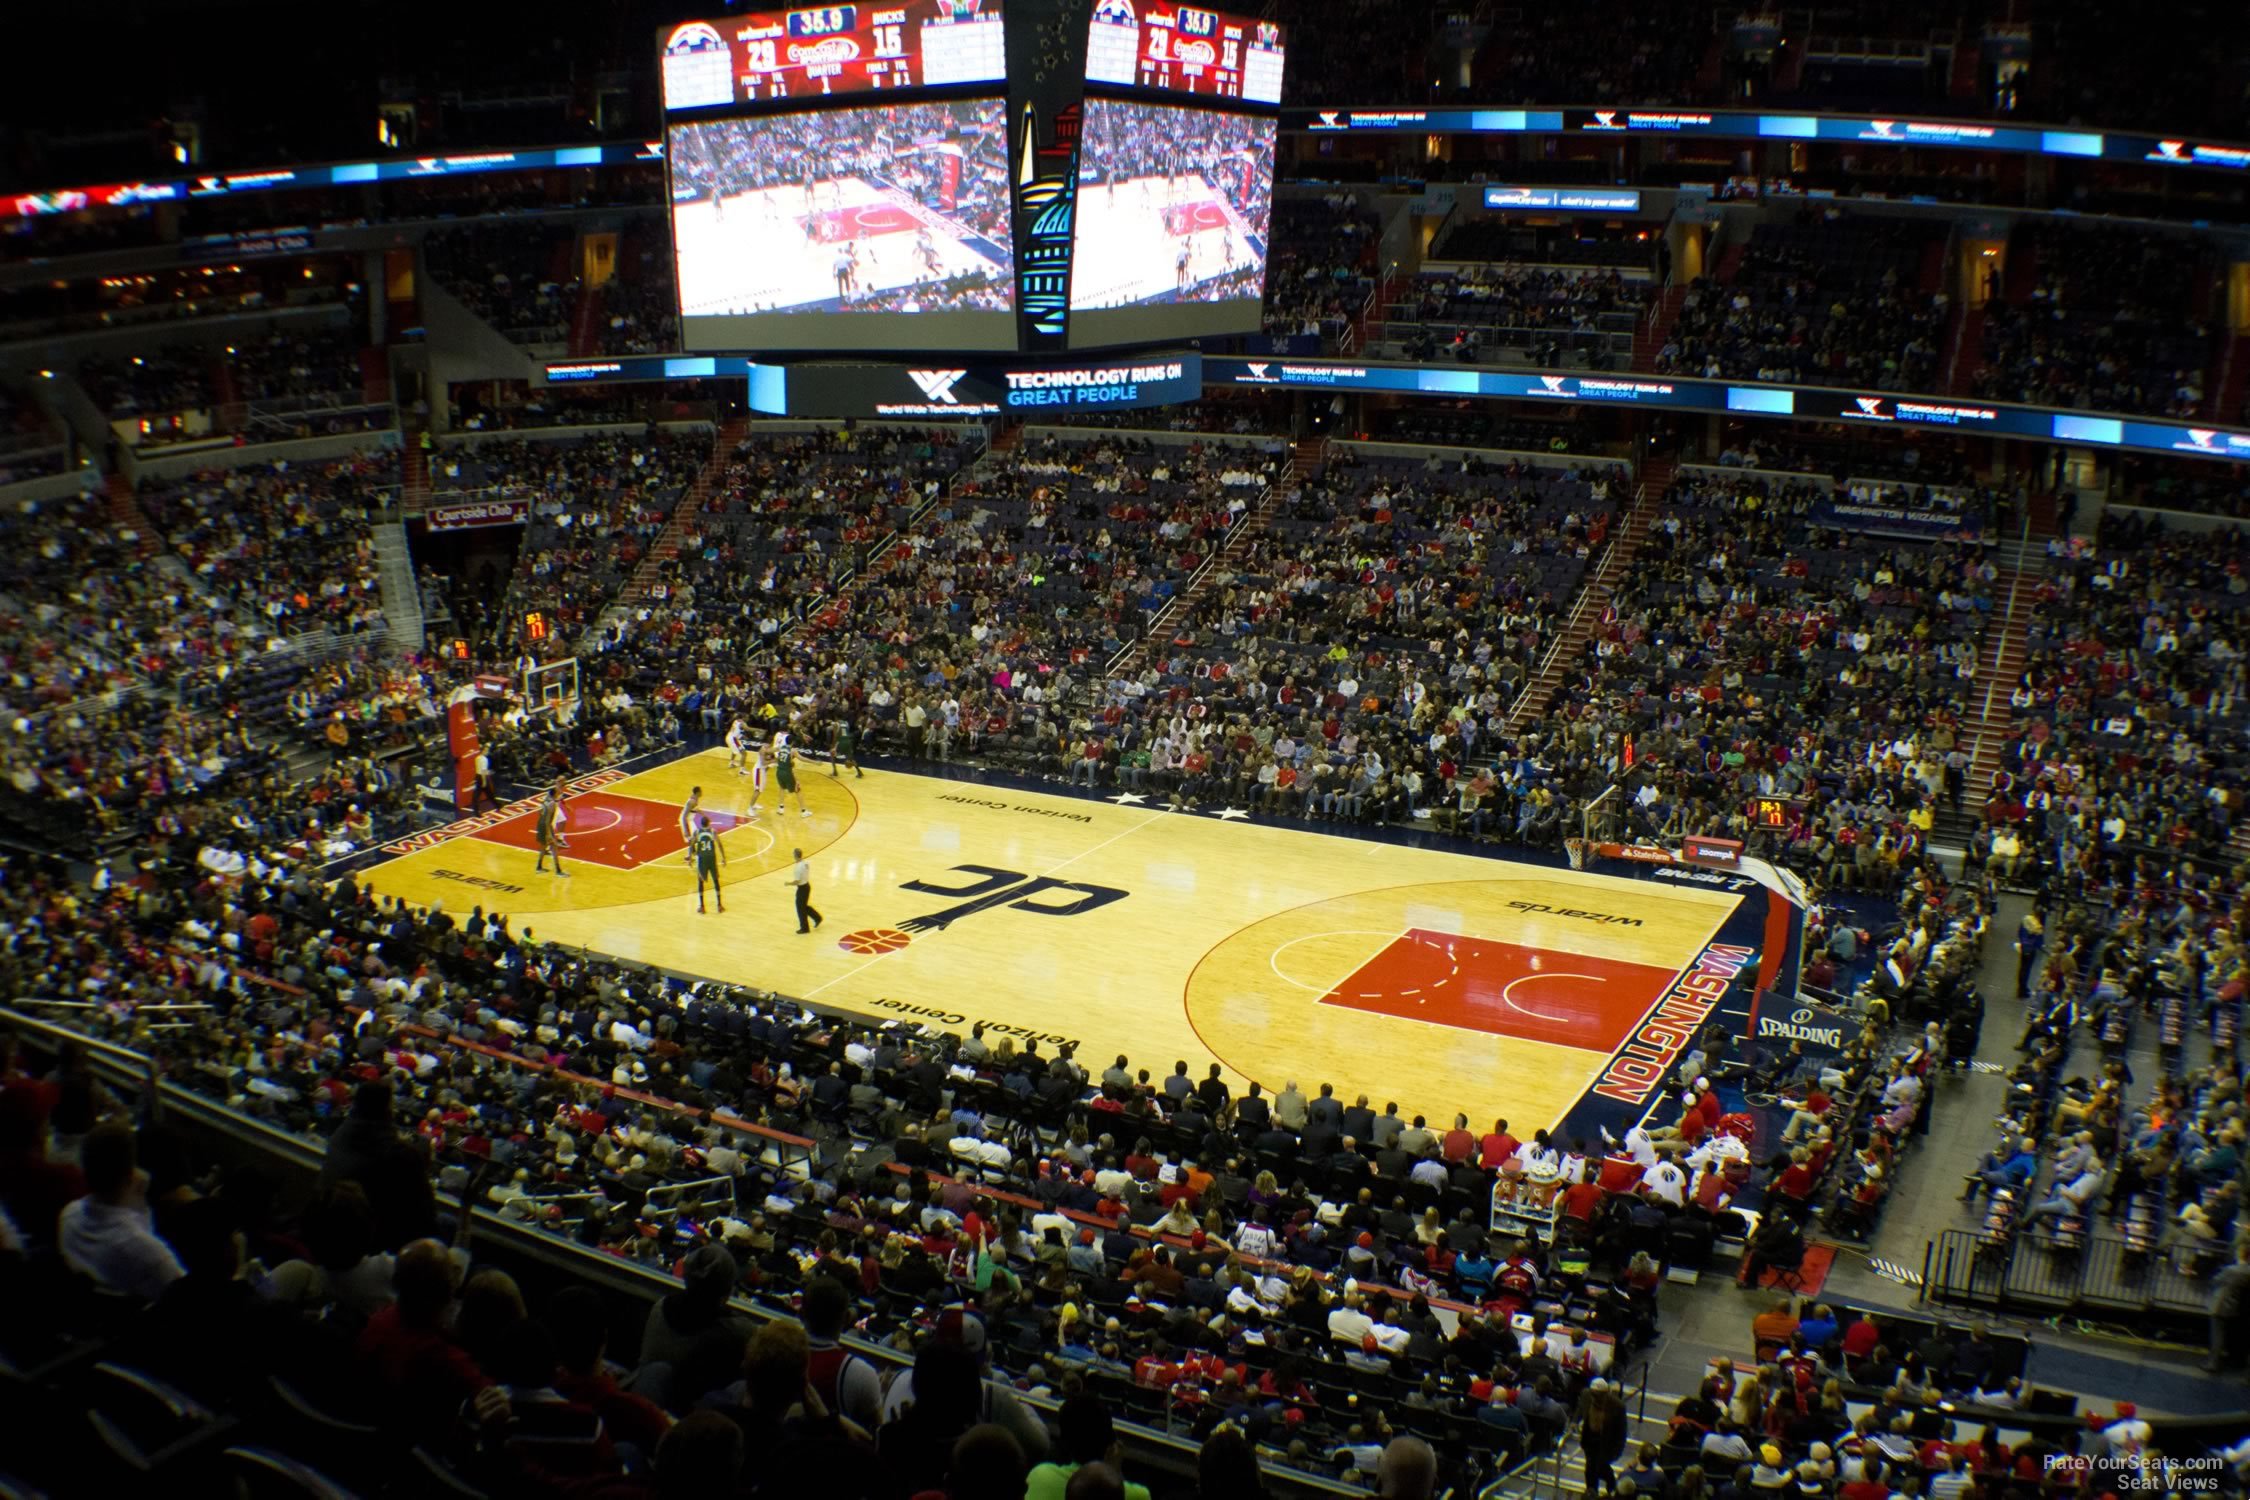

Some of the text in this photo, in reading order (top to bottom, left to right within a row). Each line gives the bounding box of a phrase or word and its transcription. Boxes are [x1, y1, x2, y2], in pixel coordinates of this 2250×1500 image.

[873, 10, 906, 25] BUCKS
[873, 26, 902, 57] 15
[1149, 28, 1168, 61] 29
[748, 40, 776, 72] 29
[807, 63, 843, 79] QUARTER
[1005, 363, 1182, 389] TECHNOLOGY RUNS ON
[1282, 366, 1366, 378] TECHNOLOGY RUNS ON
[1307, 375, 1335, 383] PEOPLE
[1008, 385, 1137, 406] GREAT PEOPLE
[1579, 380, 1673, 394] TECHNOLOGY RUNS ON
[1579, 389, 1605, 397] GREAT
[1607, 390, 1638, 399] PEOPLE
[877, 404, 903, 414] World
[904, 404, 927, 414] Wide
[983, 403, 1000, 413] Inc.
[1897, 403, 1996, 419] TECHNOLOGY RUNS ON
[1897, 411, 1924, 420] GREAT
[1926, 414, 1958, 424] PEOPLE
[436, 503, 513, 522] Courtside Club
[1834, 504, 1961, 525] WASHINGTON WIZARDS
[936, 795, 1093, 823] Verizon Center
[1770, 812, 1782, 824] 17
[701, 841, 712, 851] 34
[1698, 846, 1736, 861] zoomph
[428, 869, 525, 893] wizards
[1505, 901, 1644, 927] wizards
[869, 998, 1081, 1052] Verizon Center
[1593, 943, 1754, 1105] WASHINGTON
[1758, 1017, 1842, 1049] SPALDING
